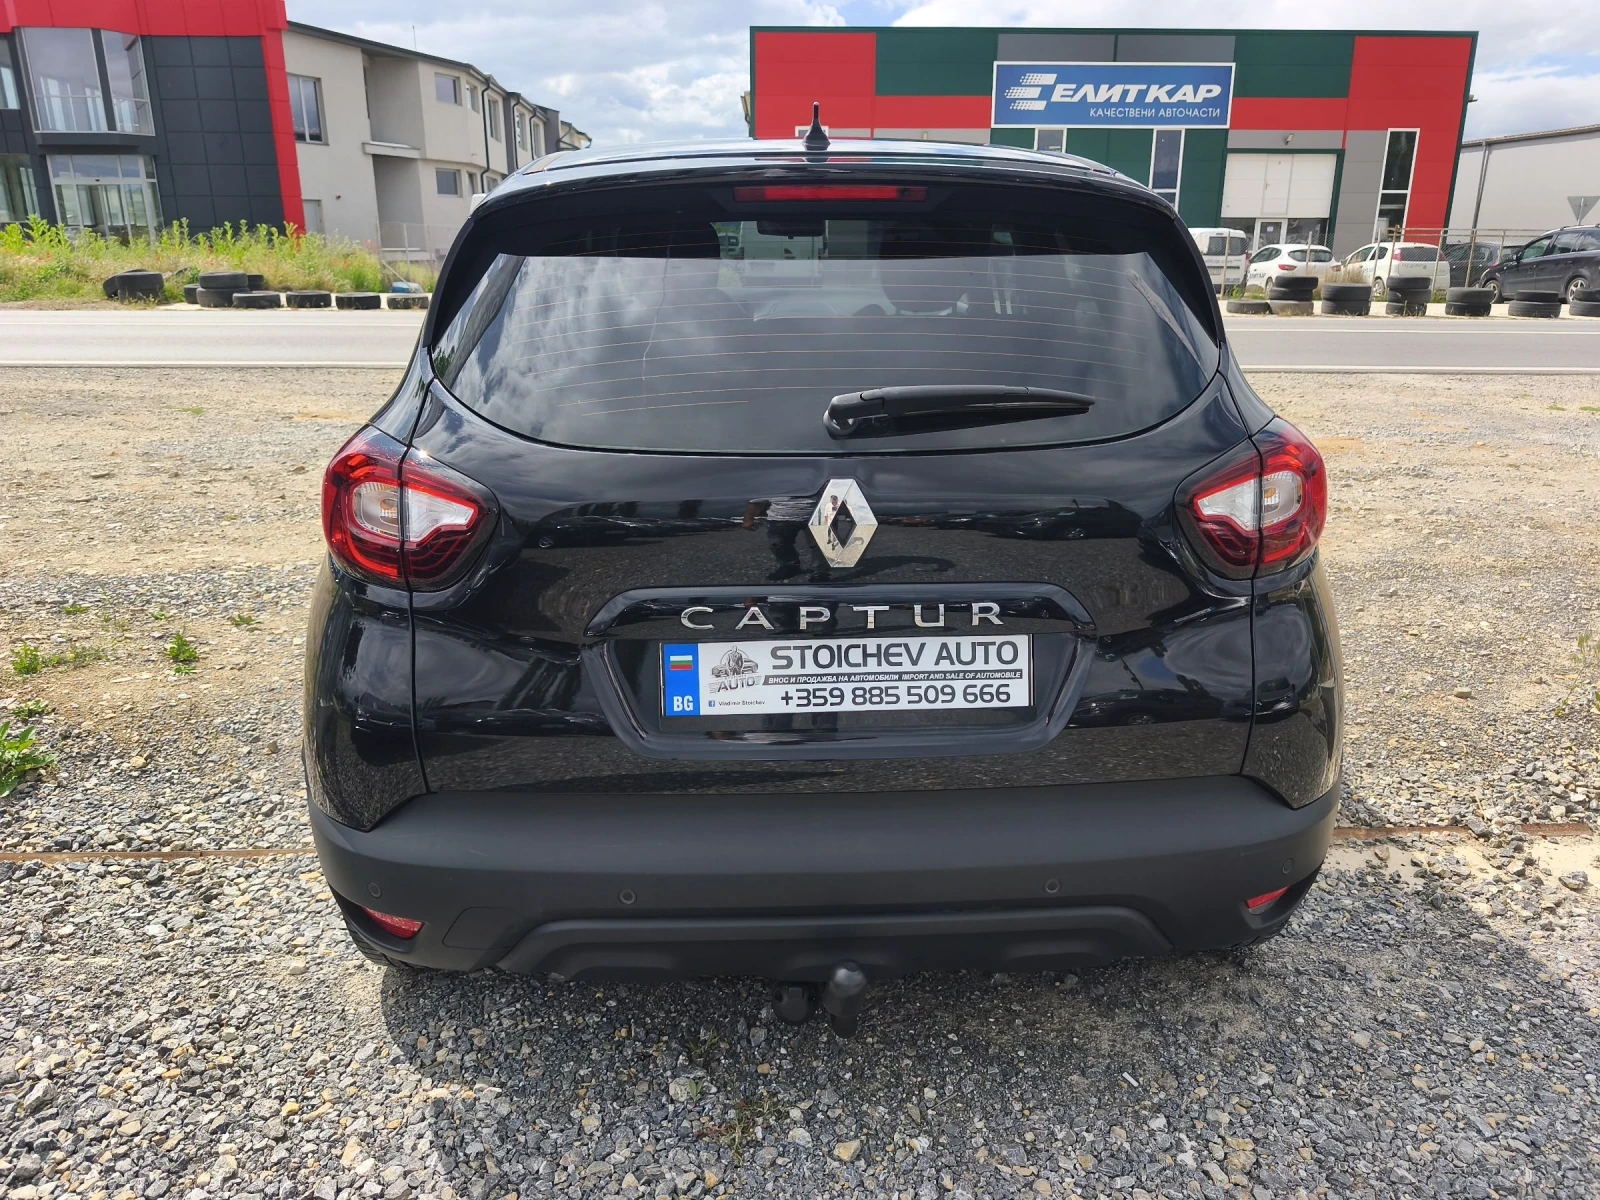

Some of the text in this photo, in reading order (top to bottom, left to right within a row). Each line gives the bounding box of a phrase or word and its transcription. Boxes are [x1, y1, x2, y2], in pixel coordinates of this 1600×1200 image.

[1050, 84, 1222, 103] ЕЛИТ КАР
[1090, 108, 1221, 118] КАЧЕСТВЕНИ АВТОЧАСТИ
[680, 602, 1004, 629] CAPTUR
[771, 640, 1019, 670] STOICHEV AUTO
[768, 676, 789, 684] ВНОС
[796, 675, 837, 684] ПРОДАЖБА
[849, 674, 899, 682] АВТОМОБИЛИ
[901, 673, 930, 681] IMPORT
[945, 672, 964, 680] SALE
[975, 671, 1021, 679] AUTOMOBILE
[717, 677, 755, 693] AUTO
[673, 695, 694, 712] BG
[780, 683, 1011, 708] +359 885 509 666
